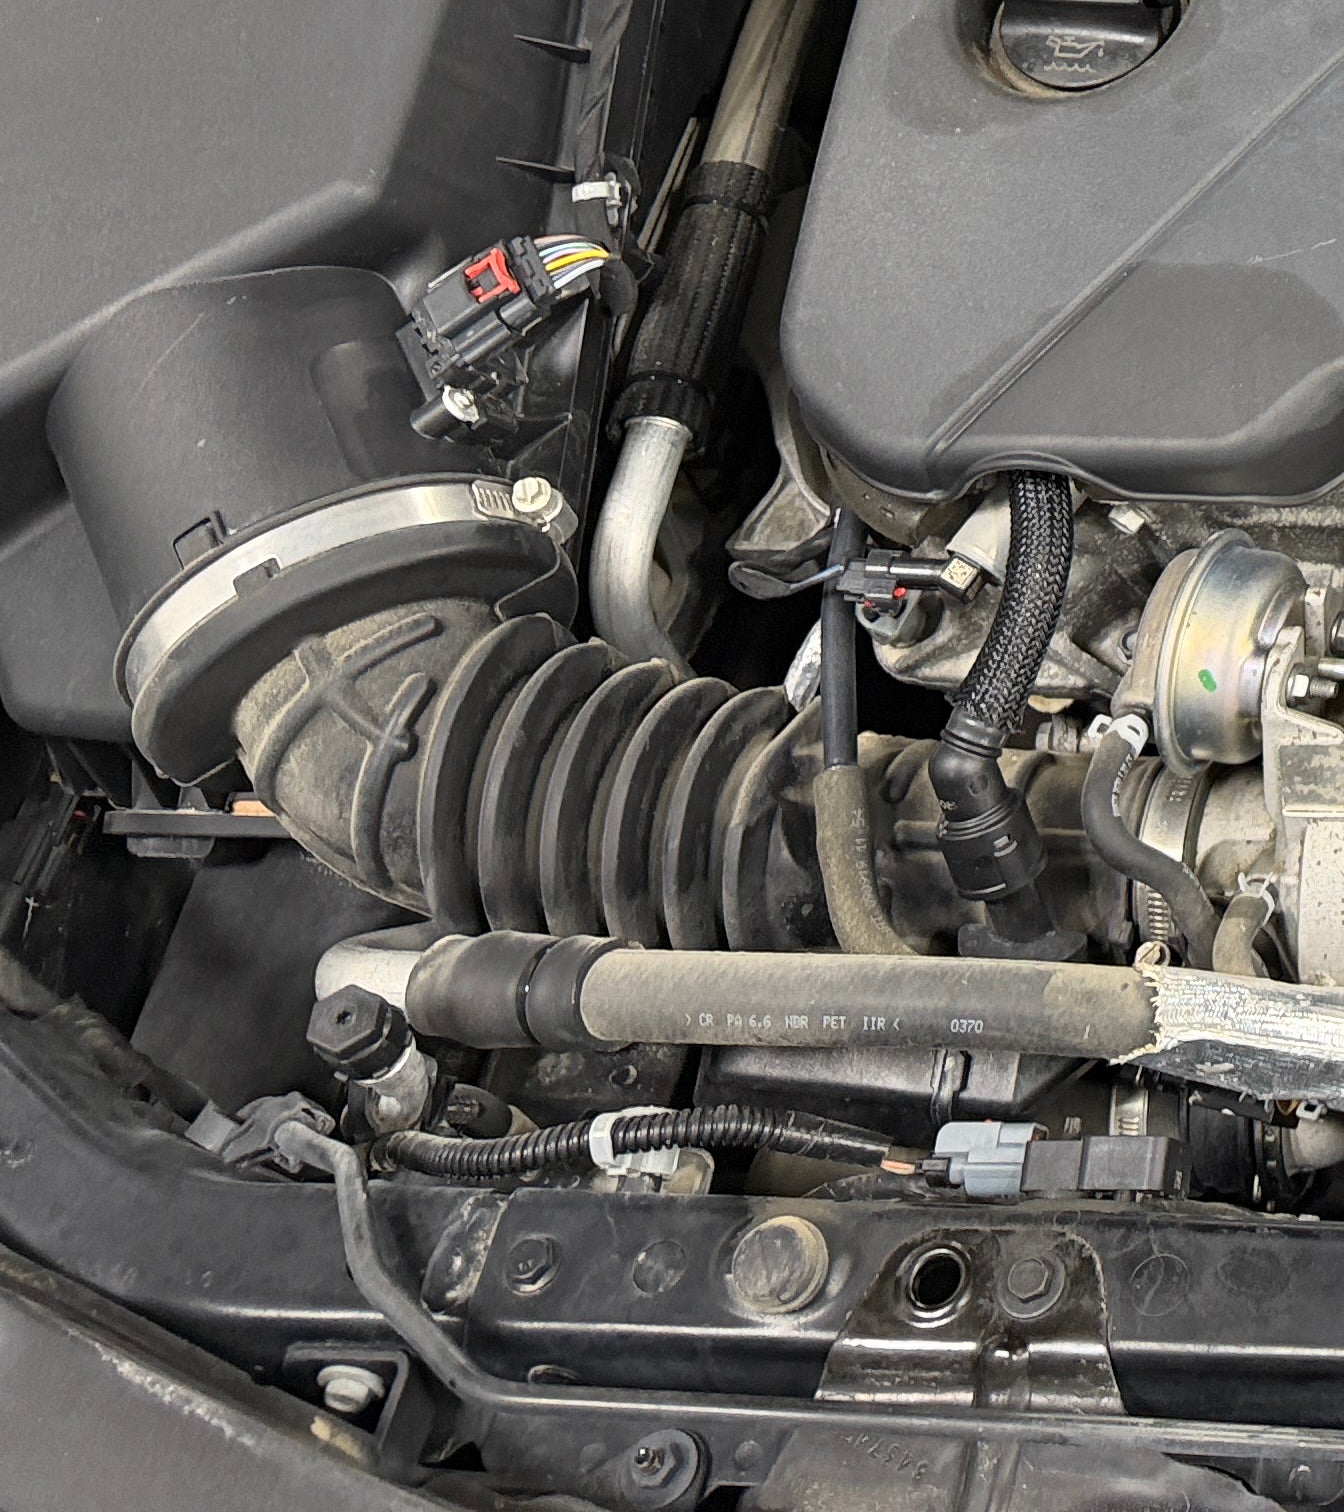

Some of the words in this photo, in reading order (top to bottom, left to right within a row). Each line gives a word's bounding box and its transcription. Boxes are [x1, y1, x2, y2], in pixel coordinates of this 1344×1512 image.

[699, 1012, 714, 1028] CR
[822, 1014, 847, 1030] PET
[950, 1018, 984, 1034] 0370
